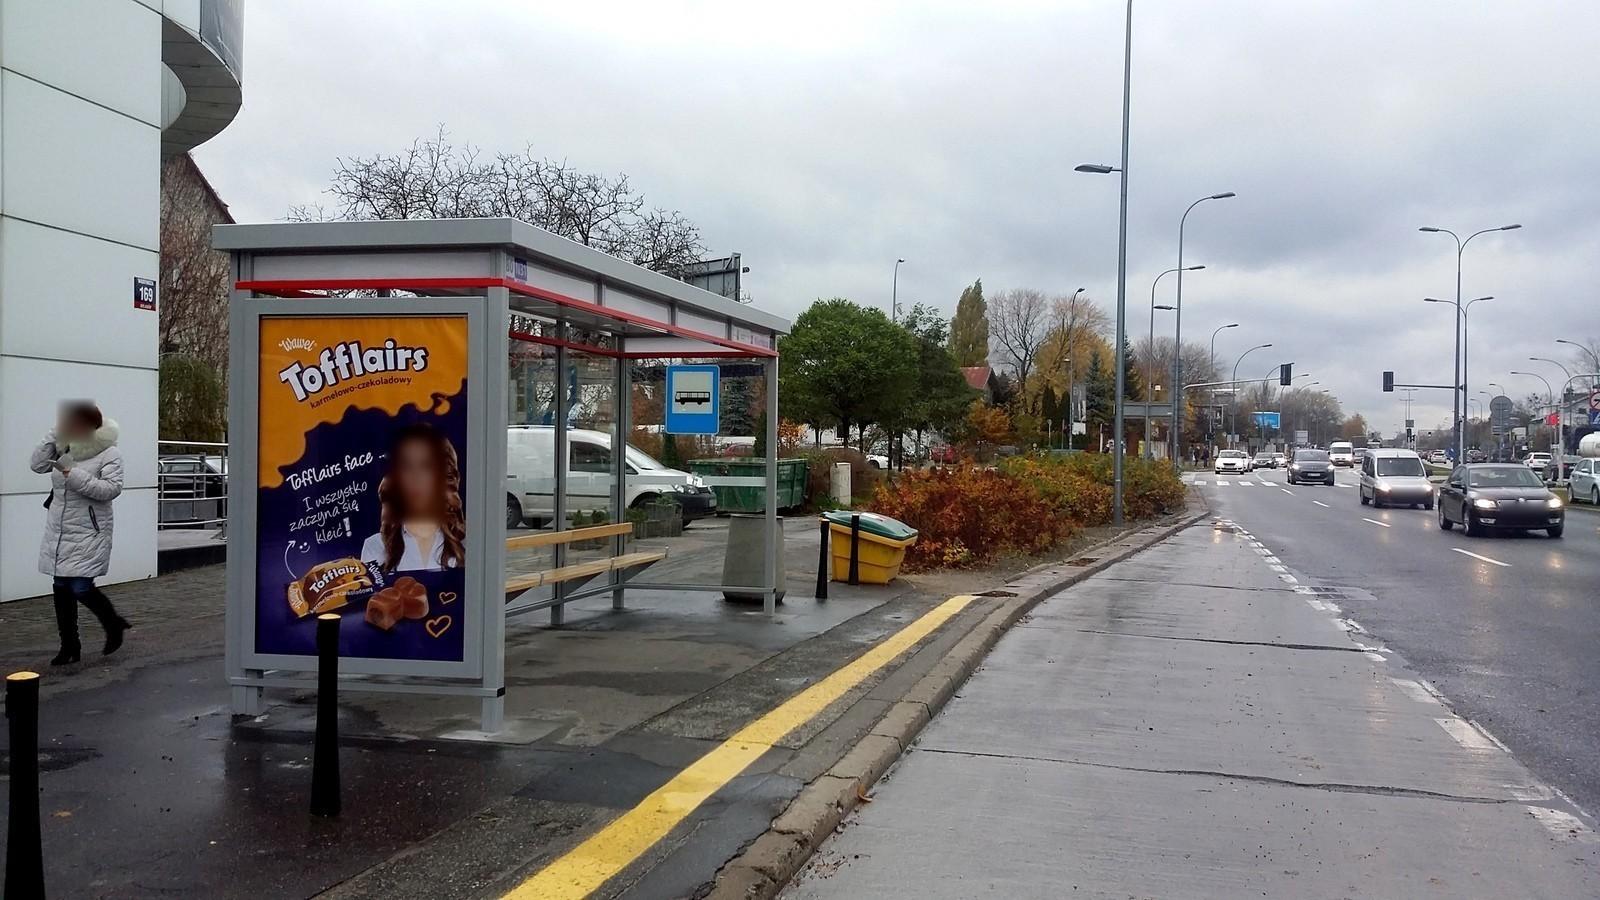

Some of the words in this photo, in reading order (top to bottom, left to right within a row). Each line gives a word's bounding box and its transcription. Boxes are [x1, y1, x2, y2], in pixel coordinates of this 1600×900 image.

[139, 286, 154, 302] 169
[279, 337, 316, 352] Wawel
[280, 339, 428, 401] Tofflairs
[310, 375, 413, 410] karmelowo-czekoladowy
[285, 463, 342, 490] Tofflairs
[344, 452, 374, 472] face
[302, 496, 314, 512] I
[315, 480, 368, 506] wszystko
[289, 506, 341, 532] zaczyna
[342, 499, 360, 513] się
[309, 565, 361, 593] Tofflairs
